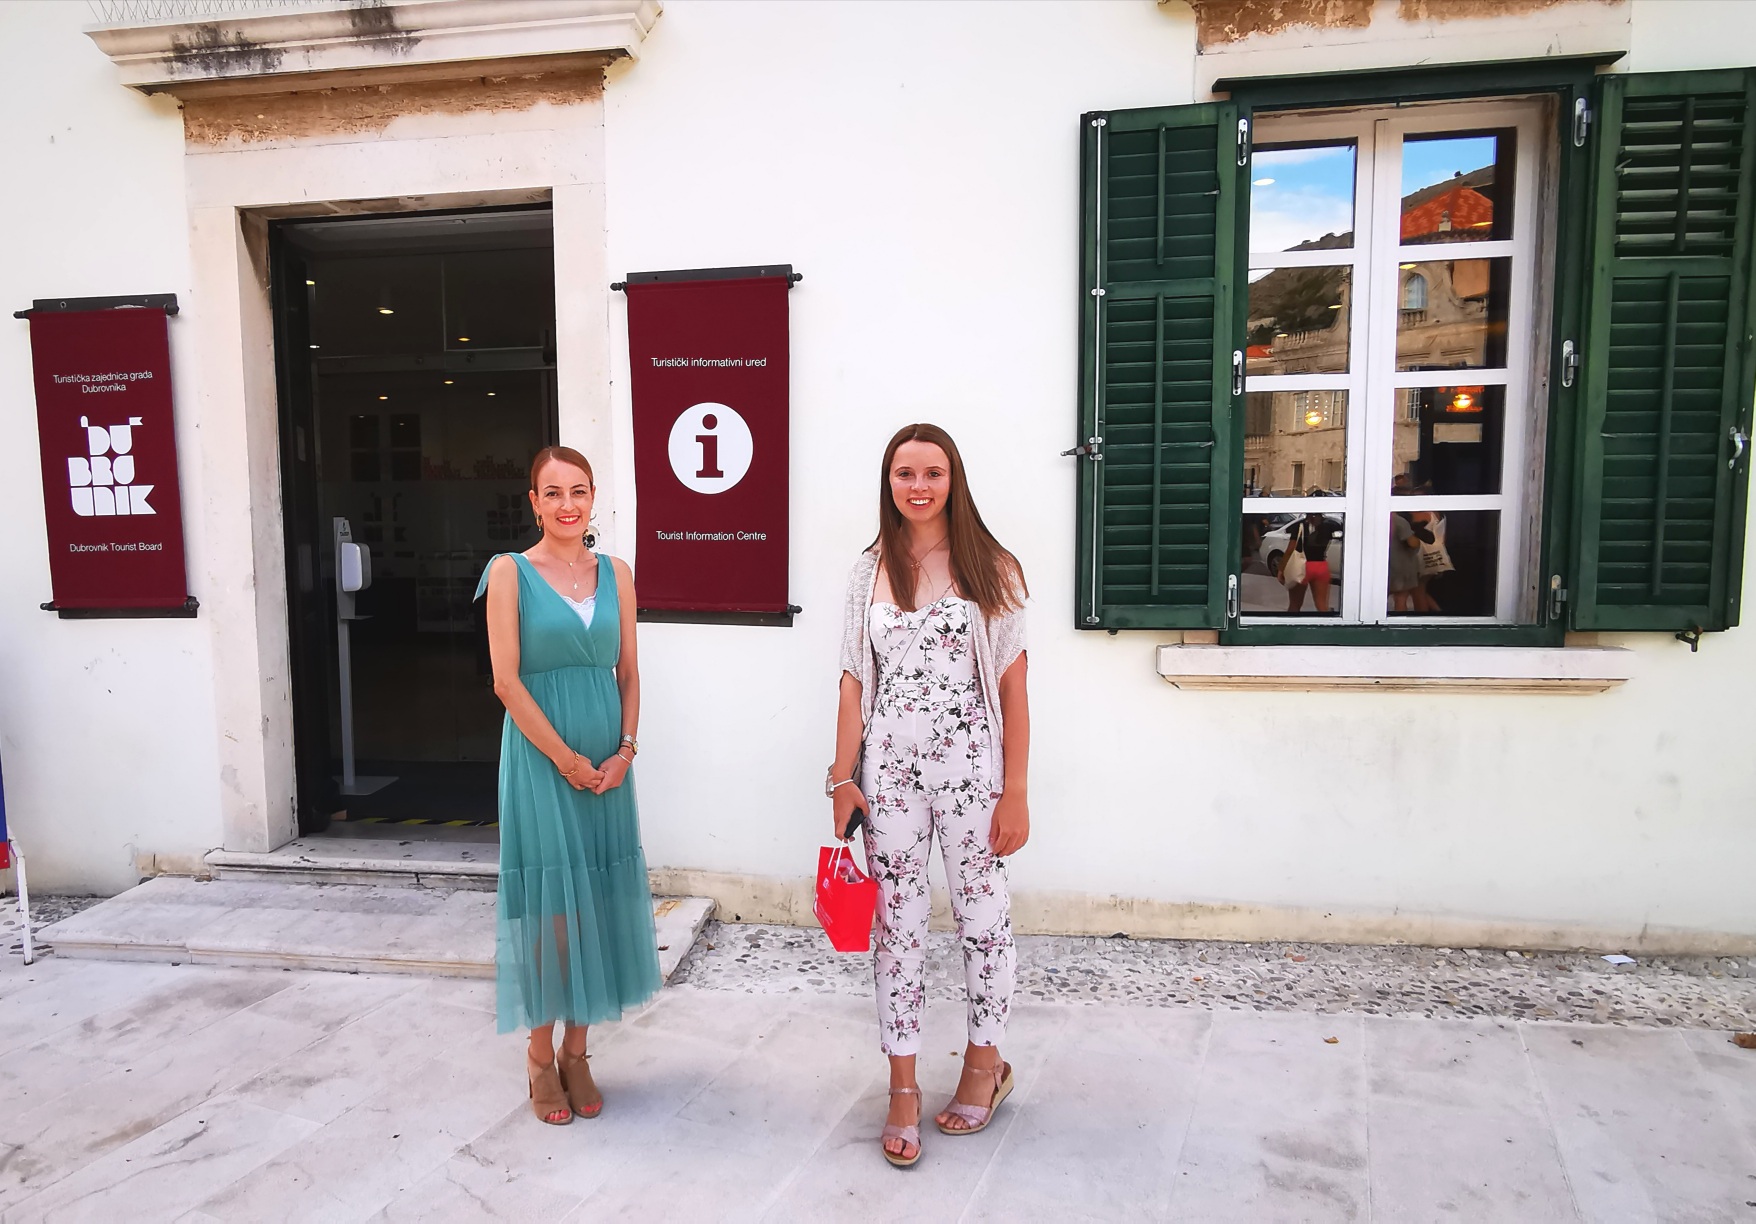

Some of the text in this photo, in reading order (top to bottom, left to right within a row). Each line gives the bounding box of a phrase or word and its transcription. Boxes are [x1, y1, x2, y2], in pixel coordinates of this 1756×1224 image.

[651, 356, 767, 367] Turistički informativni ured
[53, 370, 153, 384] Turistička zajednica grada
[82, 383, 127, 393] Dubrovnika
[656, 531, 767, 541] Tourist Information Centre
[70, 542, 163, 552] Dubrovnik Tourist Board
